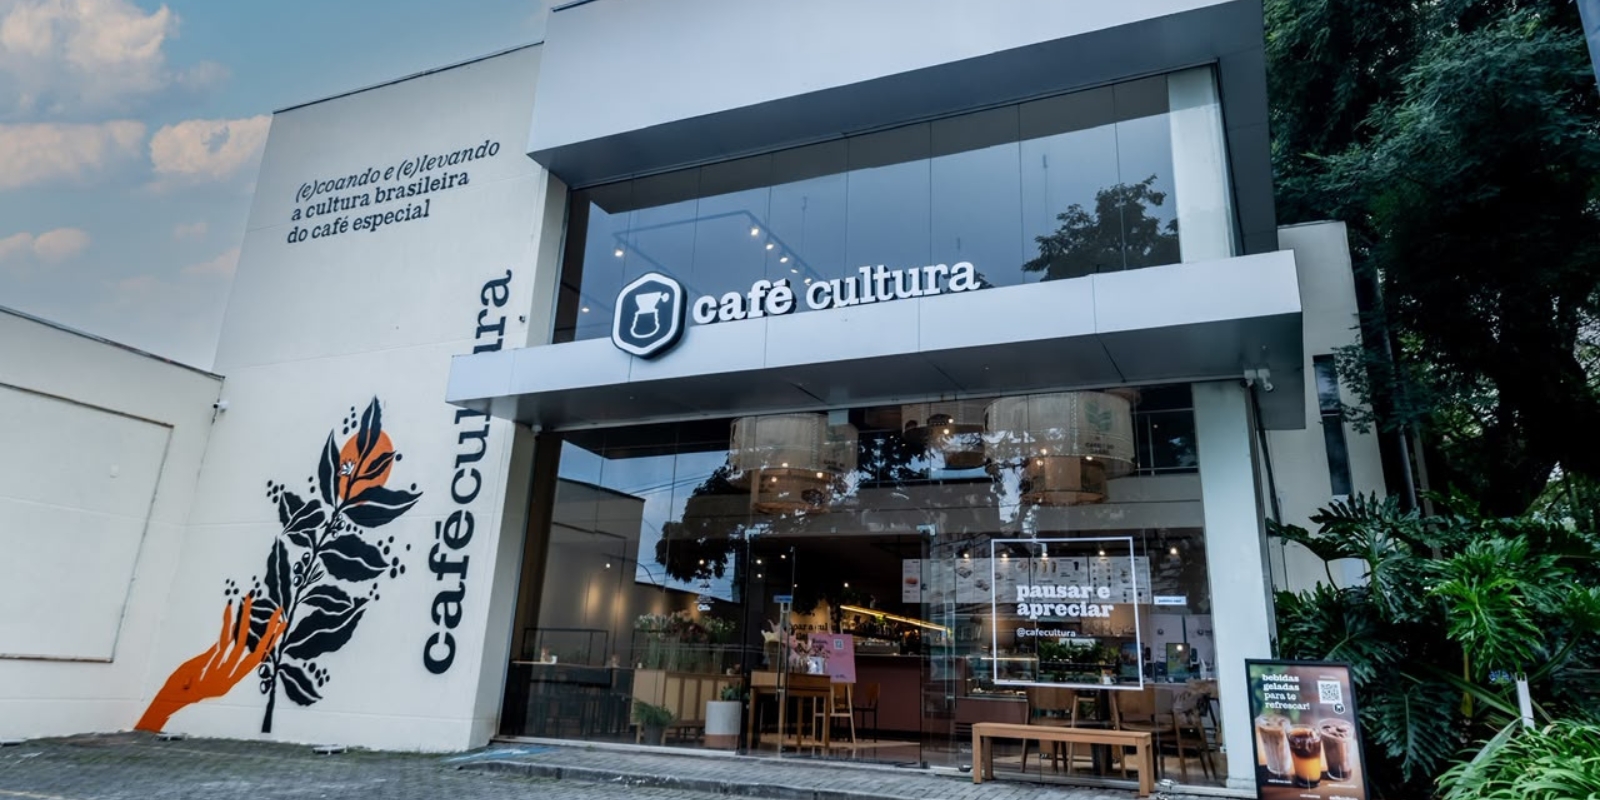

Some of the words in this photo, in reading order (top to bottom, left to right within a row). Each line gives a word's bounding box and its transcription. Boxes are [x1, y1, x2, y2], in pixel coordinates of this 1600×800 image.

[295, 167, 381, 203] (e)coando
[384, 166, 395, 180] e
[396, 139, 500, 182] (e)levando
[291, 208, 302, 221] a
[305, 192, 371, 219] cultura
[375, 171, 470, 204] brasileira
[287, 226, 308, 244] do
[312, 216, 349, 239] café
[352, 199, 431, 232] especial
[692, 277, 796, 325] café
[806, 261, 981, 312] cultura
[1016, 584, 1094, 601] pausar
[1097, 586, 1111, 599] e
[1016, 601, 1114, 620] apreciar
[1016, 628, 1077, 638] @cafecultura
[1261, 674, 1300, 682] bebidas
[1263, 683, 1300, 691] geladas
[1264, 692, 1286, 701] para
[1265, 702, 1311, 710] refrescar!
